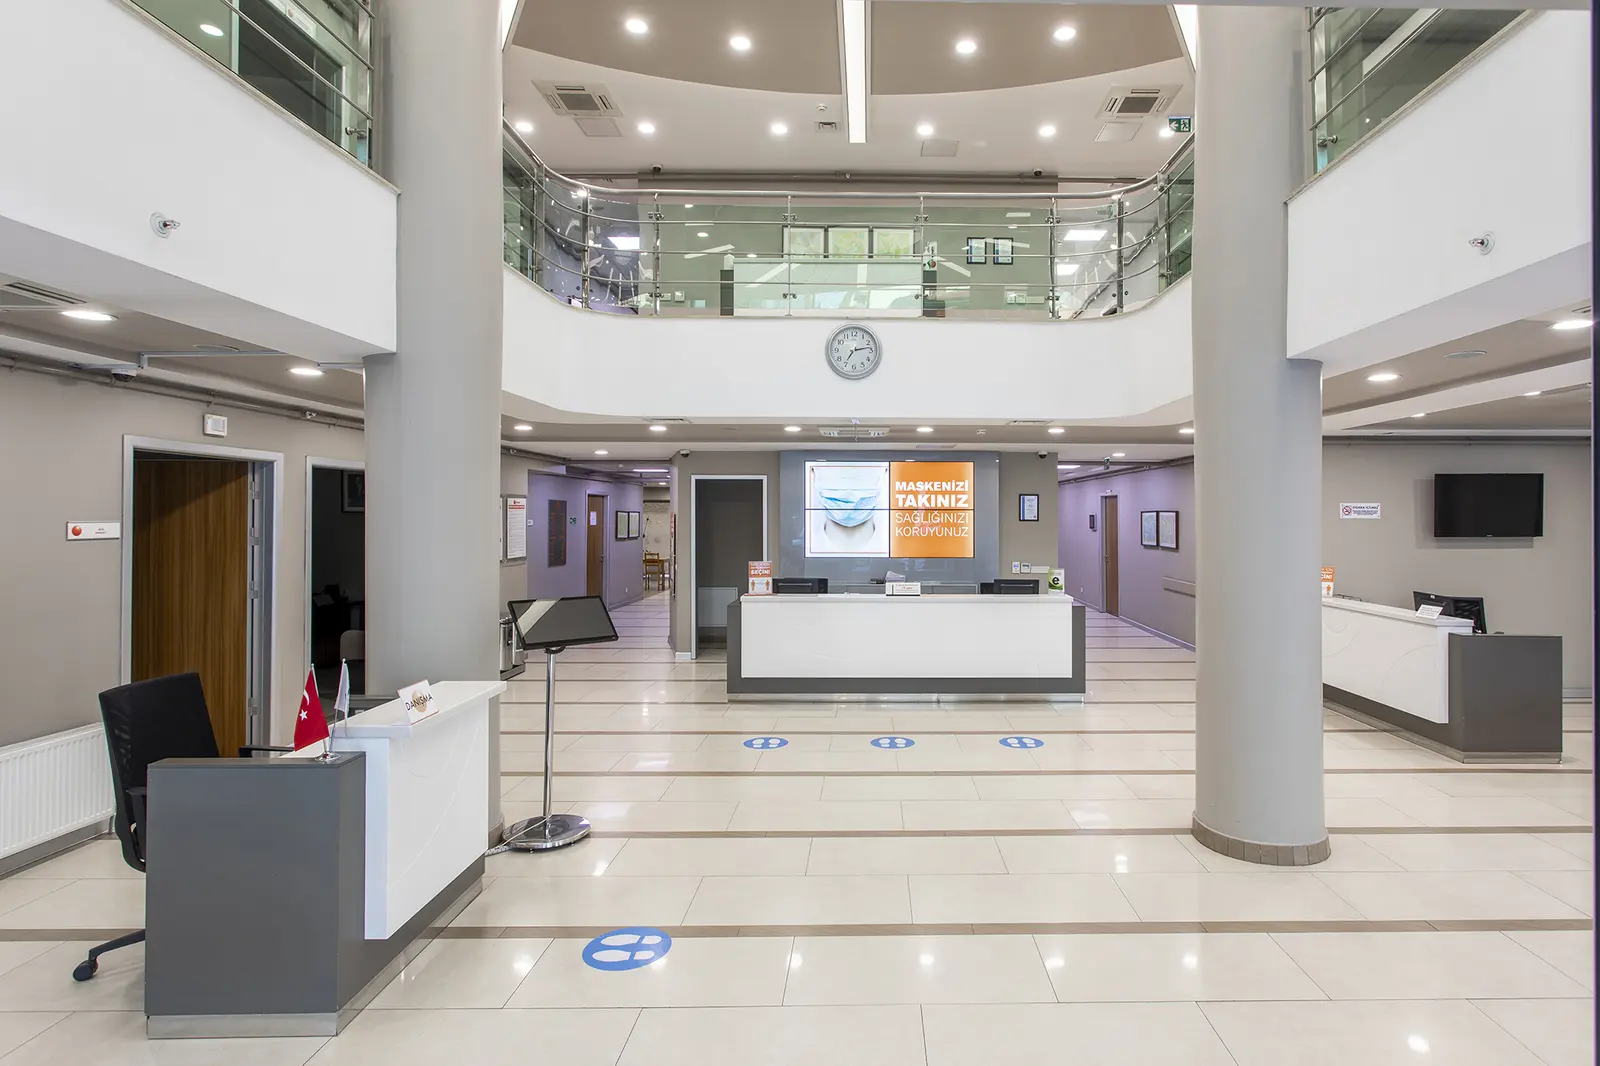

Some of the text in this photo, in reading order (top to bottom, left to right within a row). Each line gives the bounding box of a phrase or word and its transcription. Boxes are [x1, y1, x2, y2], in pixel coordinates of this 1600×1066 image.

[895, 480, 969, 492] MASKENİZİ
[895, 494, 969, 508] TAKINIZ
[895, 510, 969, 524] SAĞLIĞINIZI
[895, 526, 969, 537] KORUYUNUZ
[1052, 576, 1060, 585] e
[404, 692, 434, 711] DANIŞMA
